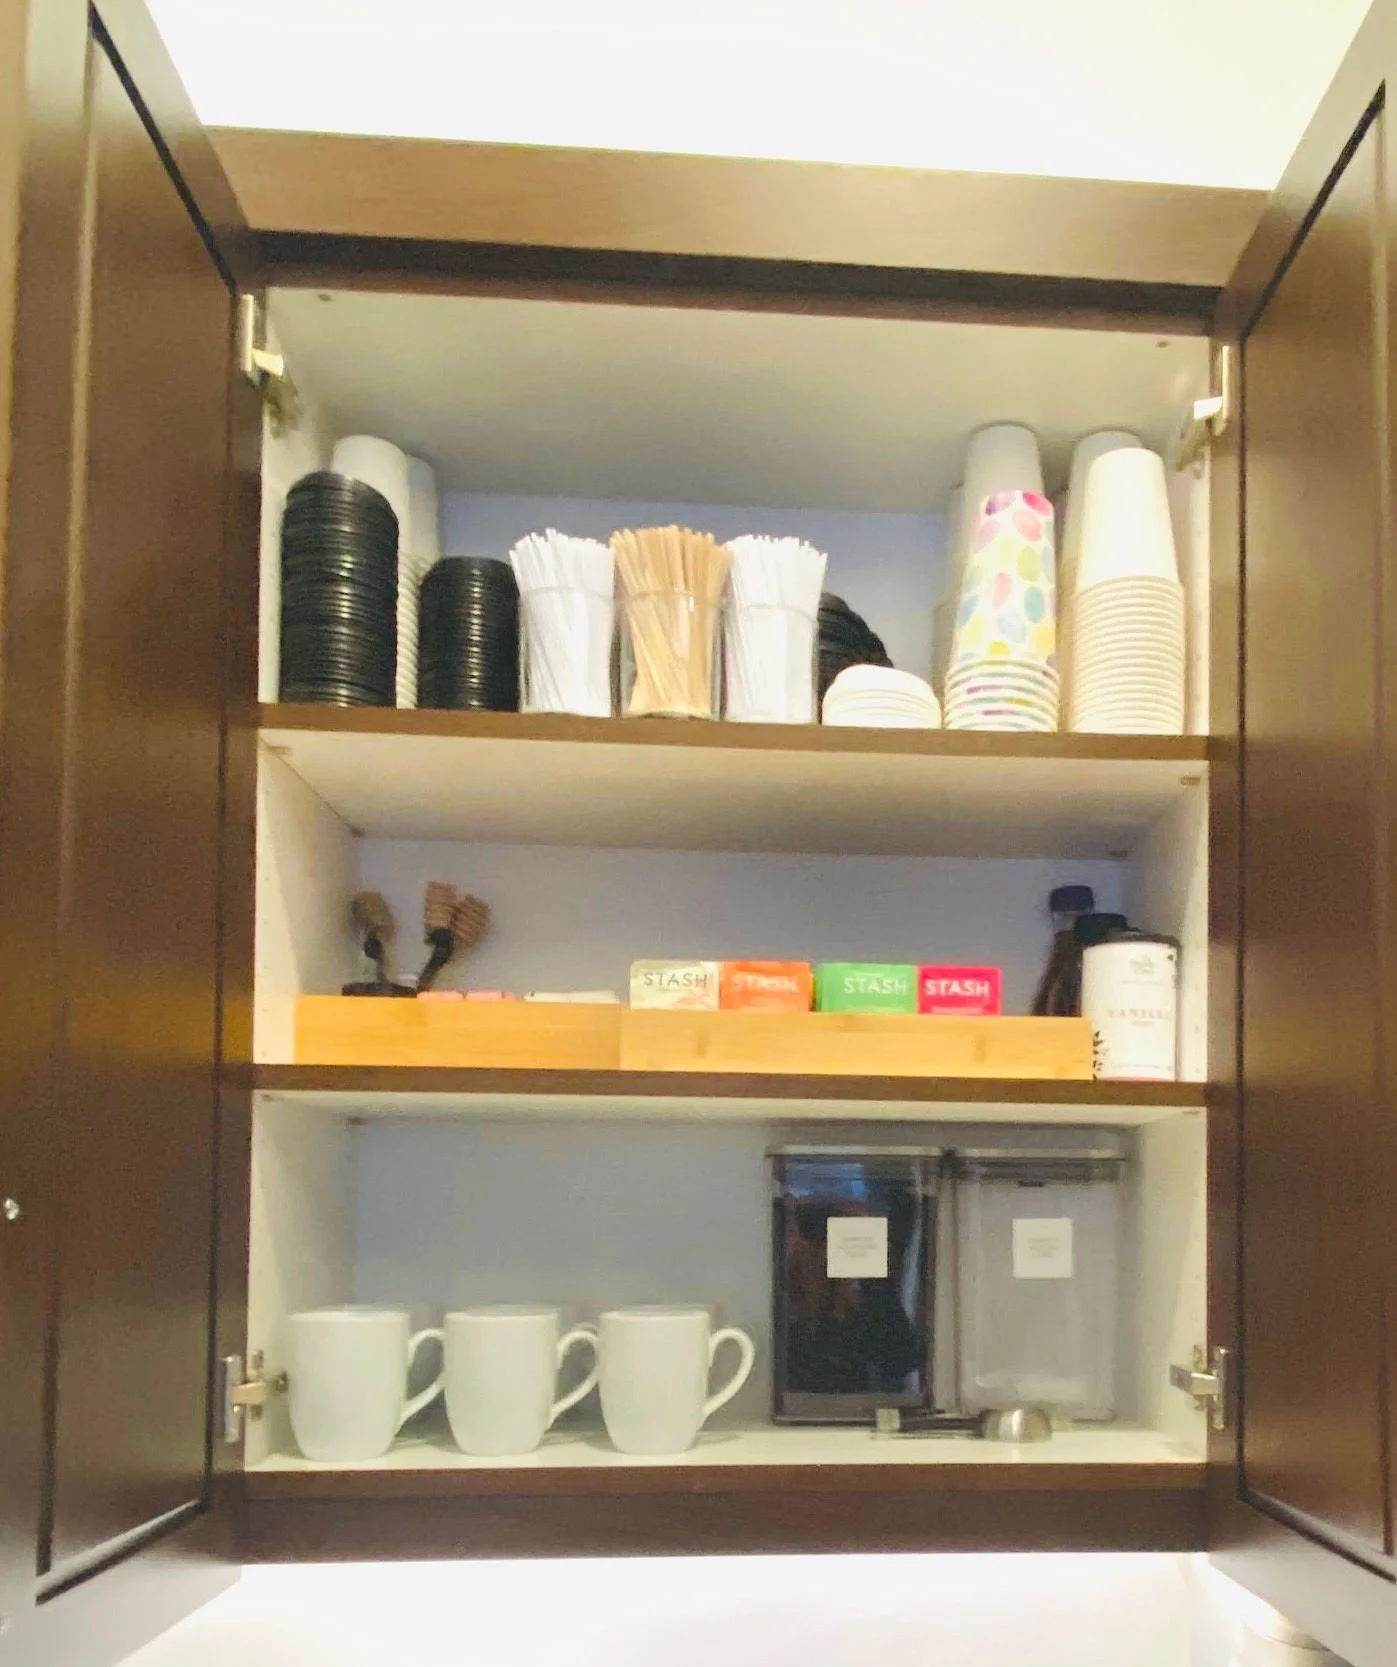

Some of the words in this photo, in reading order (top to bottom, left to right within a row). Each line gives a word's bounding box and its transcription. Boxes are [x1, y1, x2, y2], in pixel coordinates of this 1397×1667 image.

[643, 972, 707, 988] STASH
[731, 973, 798, 992] STASH
[843, 977, 907, 995] STASH
[924, 979, 989, 996] STASH
